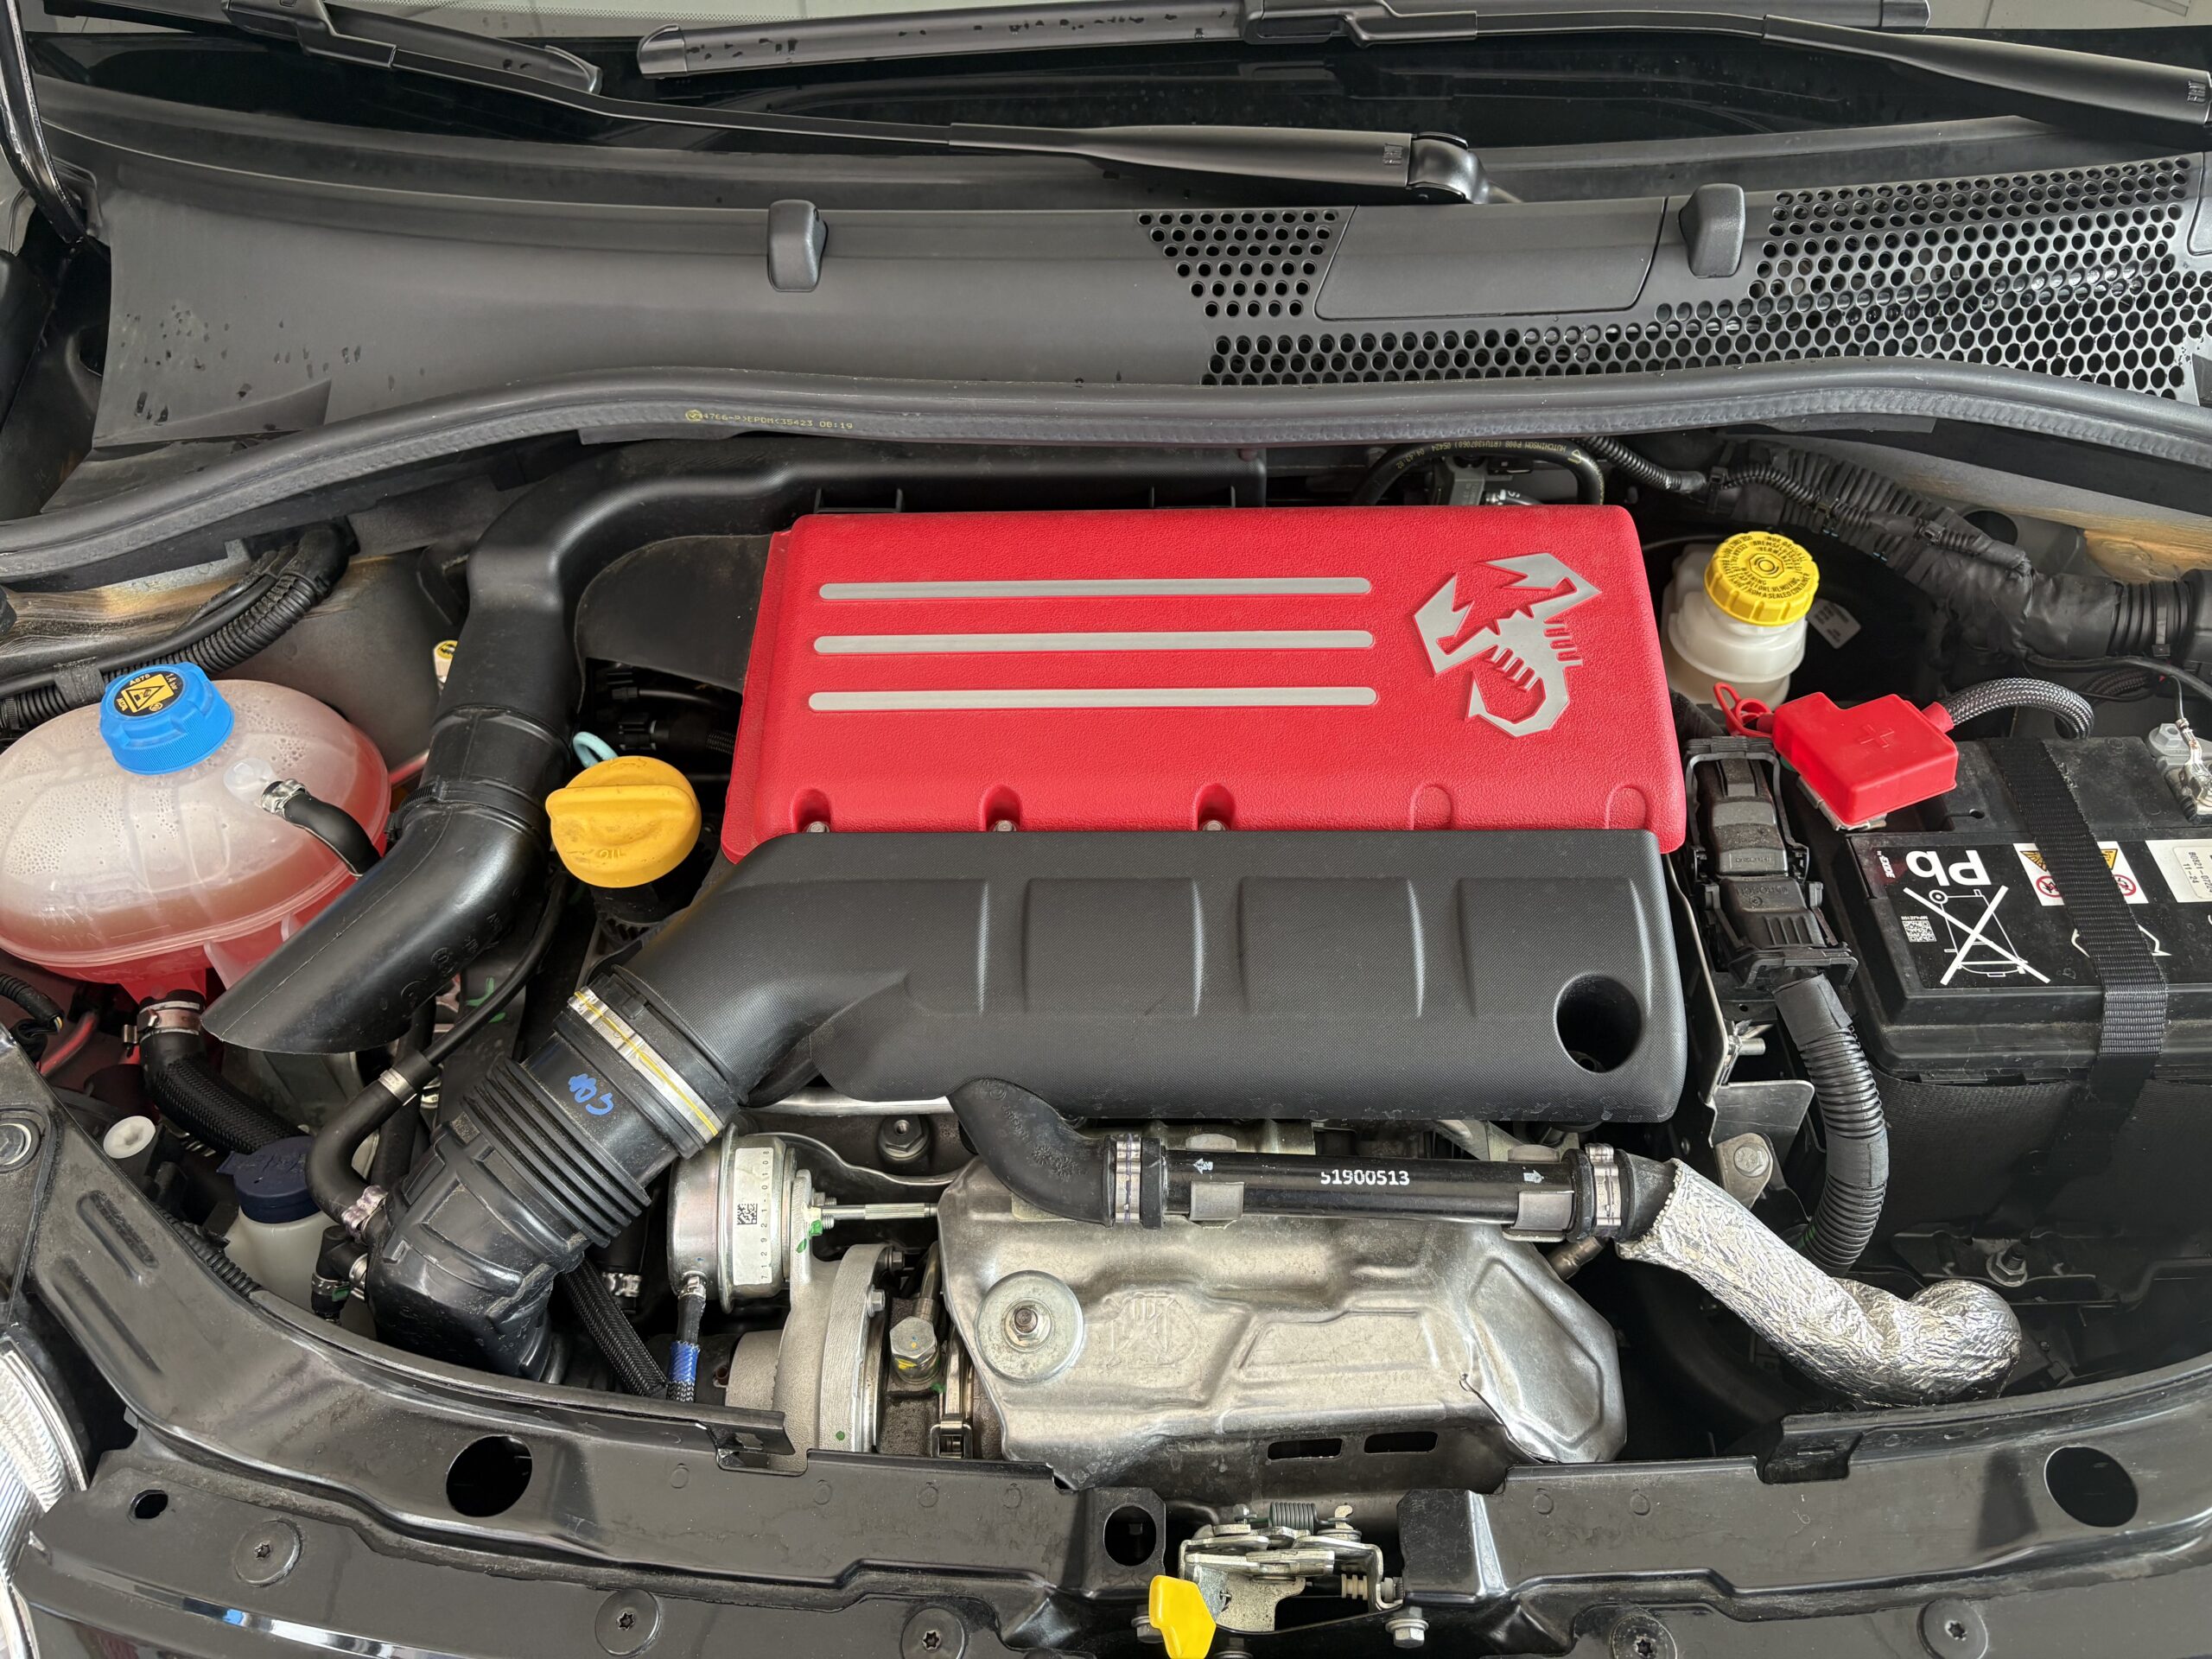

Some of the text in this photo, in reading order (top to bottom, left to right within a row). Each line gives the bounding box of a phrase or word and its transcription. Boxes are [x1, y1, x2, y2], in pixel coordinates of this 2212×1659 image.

[599, 849, 626, 859] OIL
[1878, 855, 1896, 879] EXIDE
[1905, 849, 1992, 887] Pb
[2183, 863, 2200, 884] 11-24
[1319, 1169, 1411, 1186] 51900513
